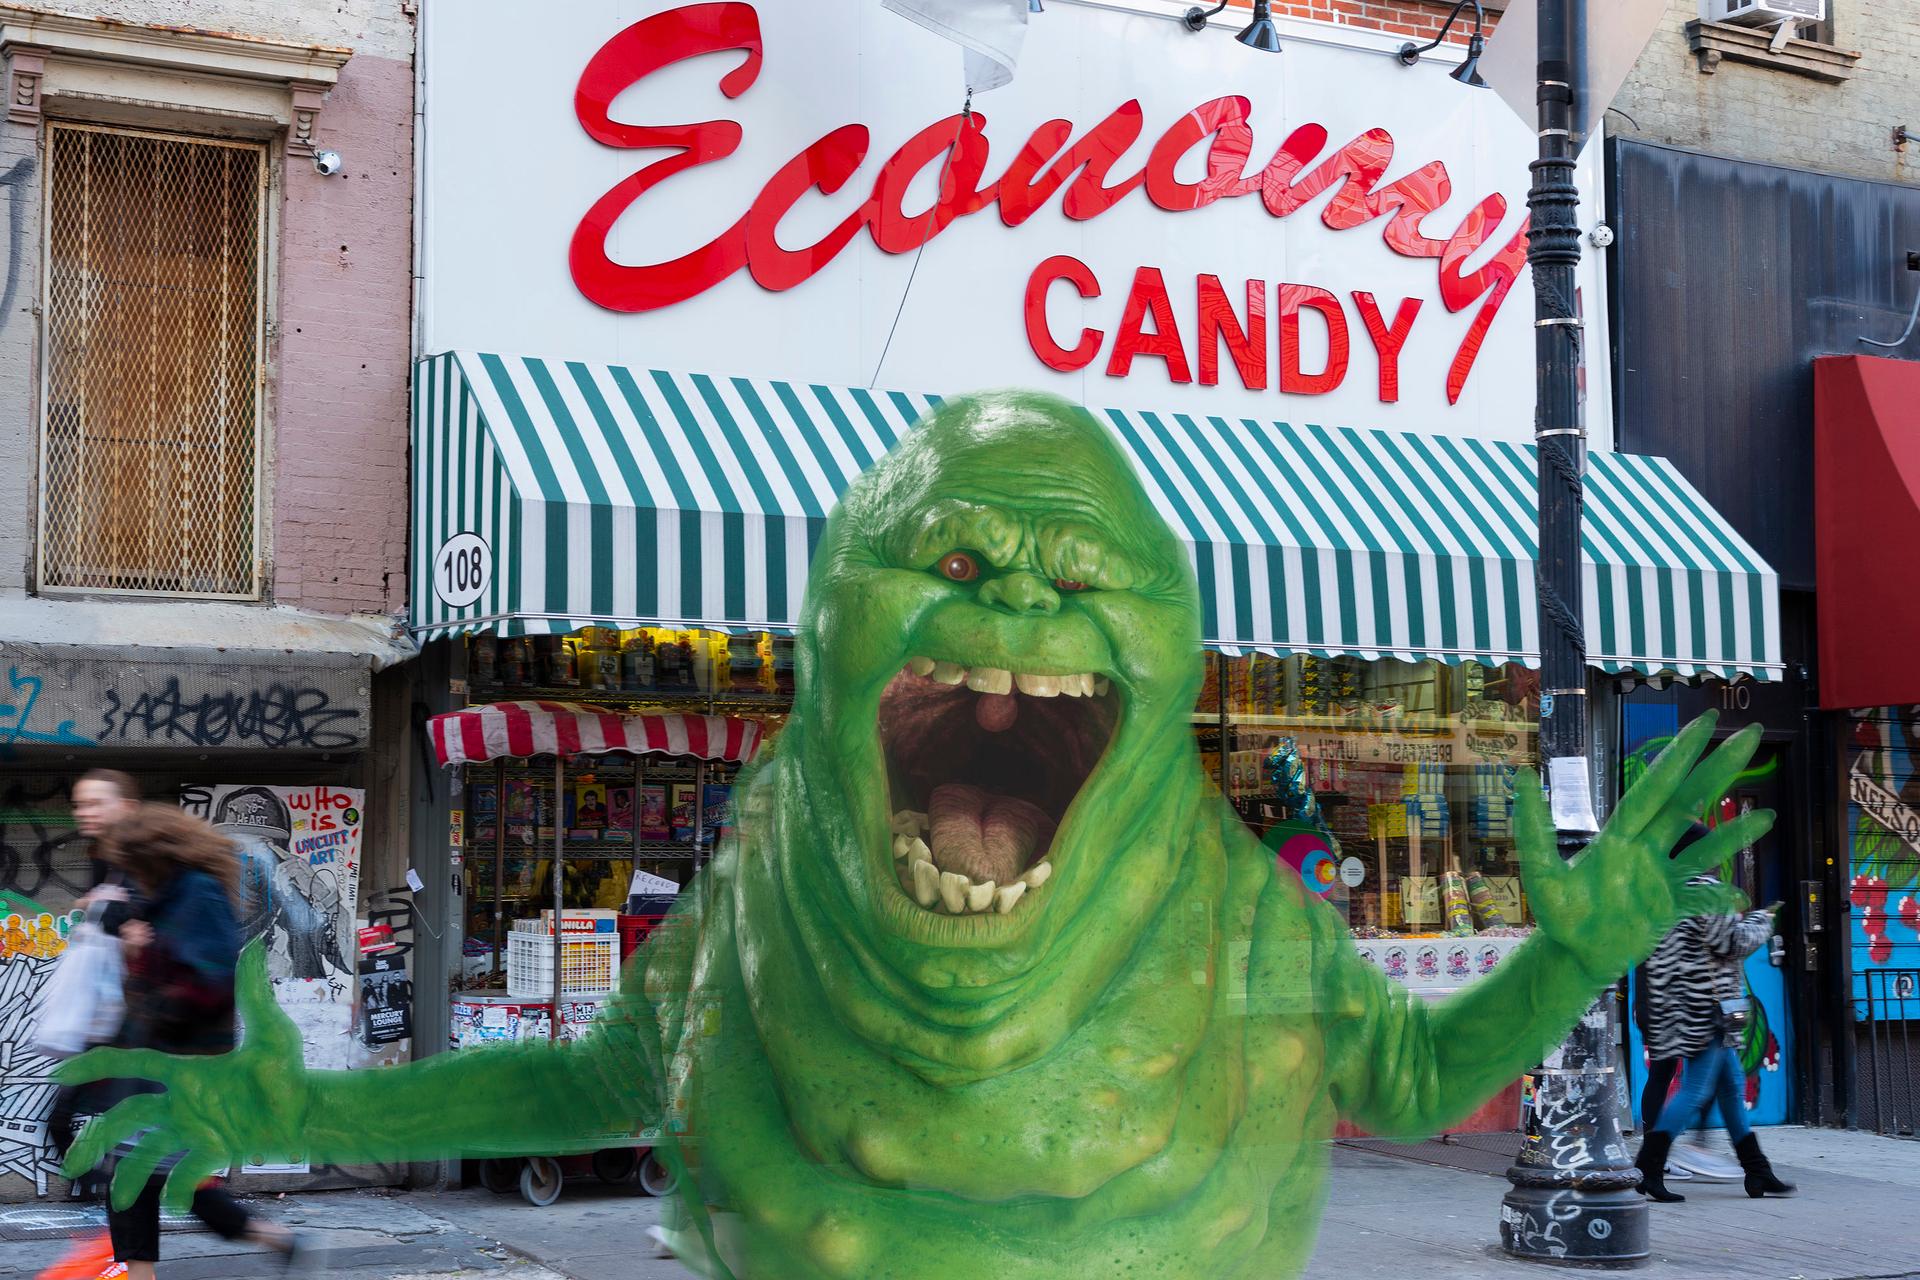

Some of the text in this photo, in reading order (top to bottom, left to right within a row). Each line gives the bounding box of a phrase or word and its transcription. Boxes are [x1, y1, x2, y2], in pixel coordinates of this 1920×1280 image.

[568, 2, 1530, 405] Economy
[1024, 254, 1424, 403] CANDY
[444, 546, 482, 593] 108
[1721, 685, 1750, 710] 110
[288, 786, 353, 811] WHO
[309, 848, 335, 866] ART
[370, 1010, 404, 1021] MERCURY
